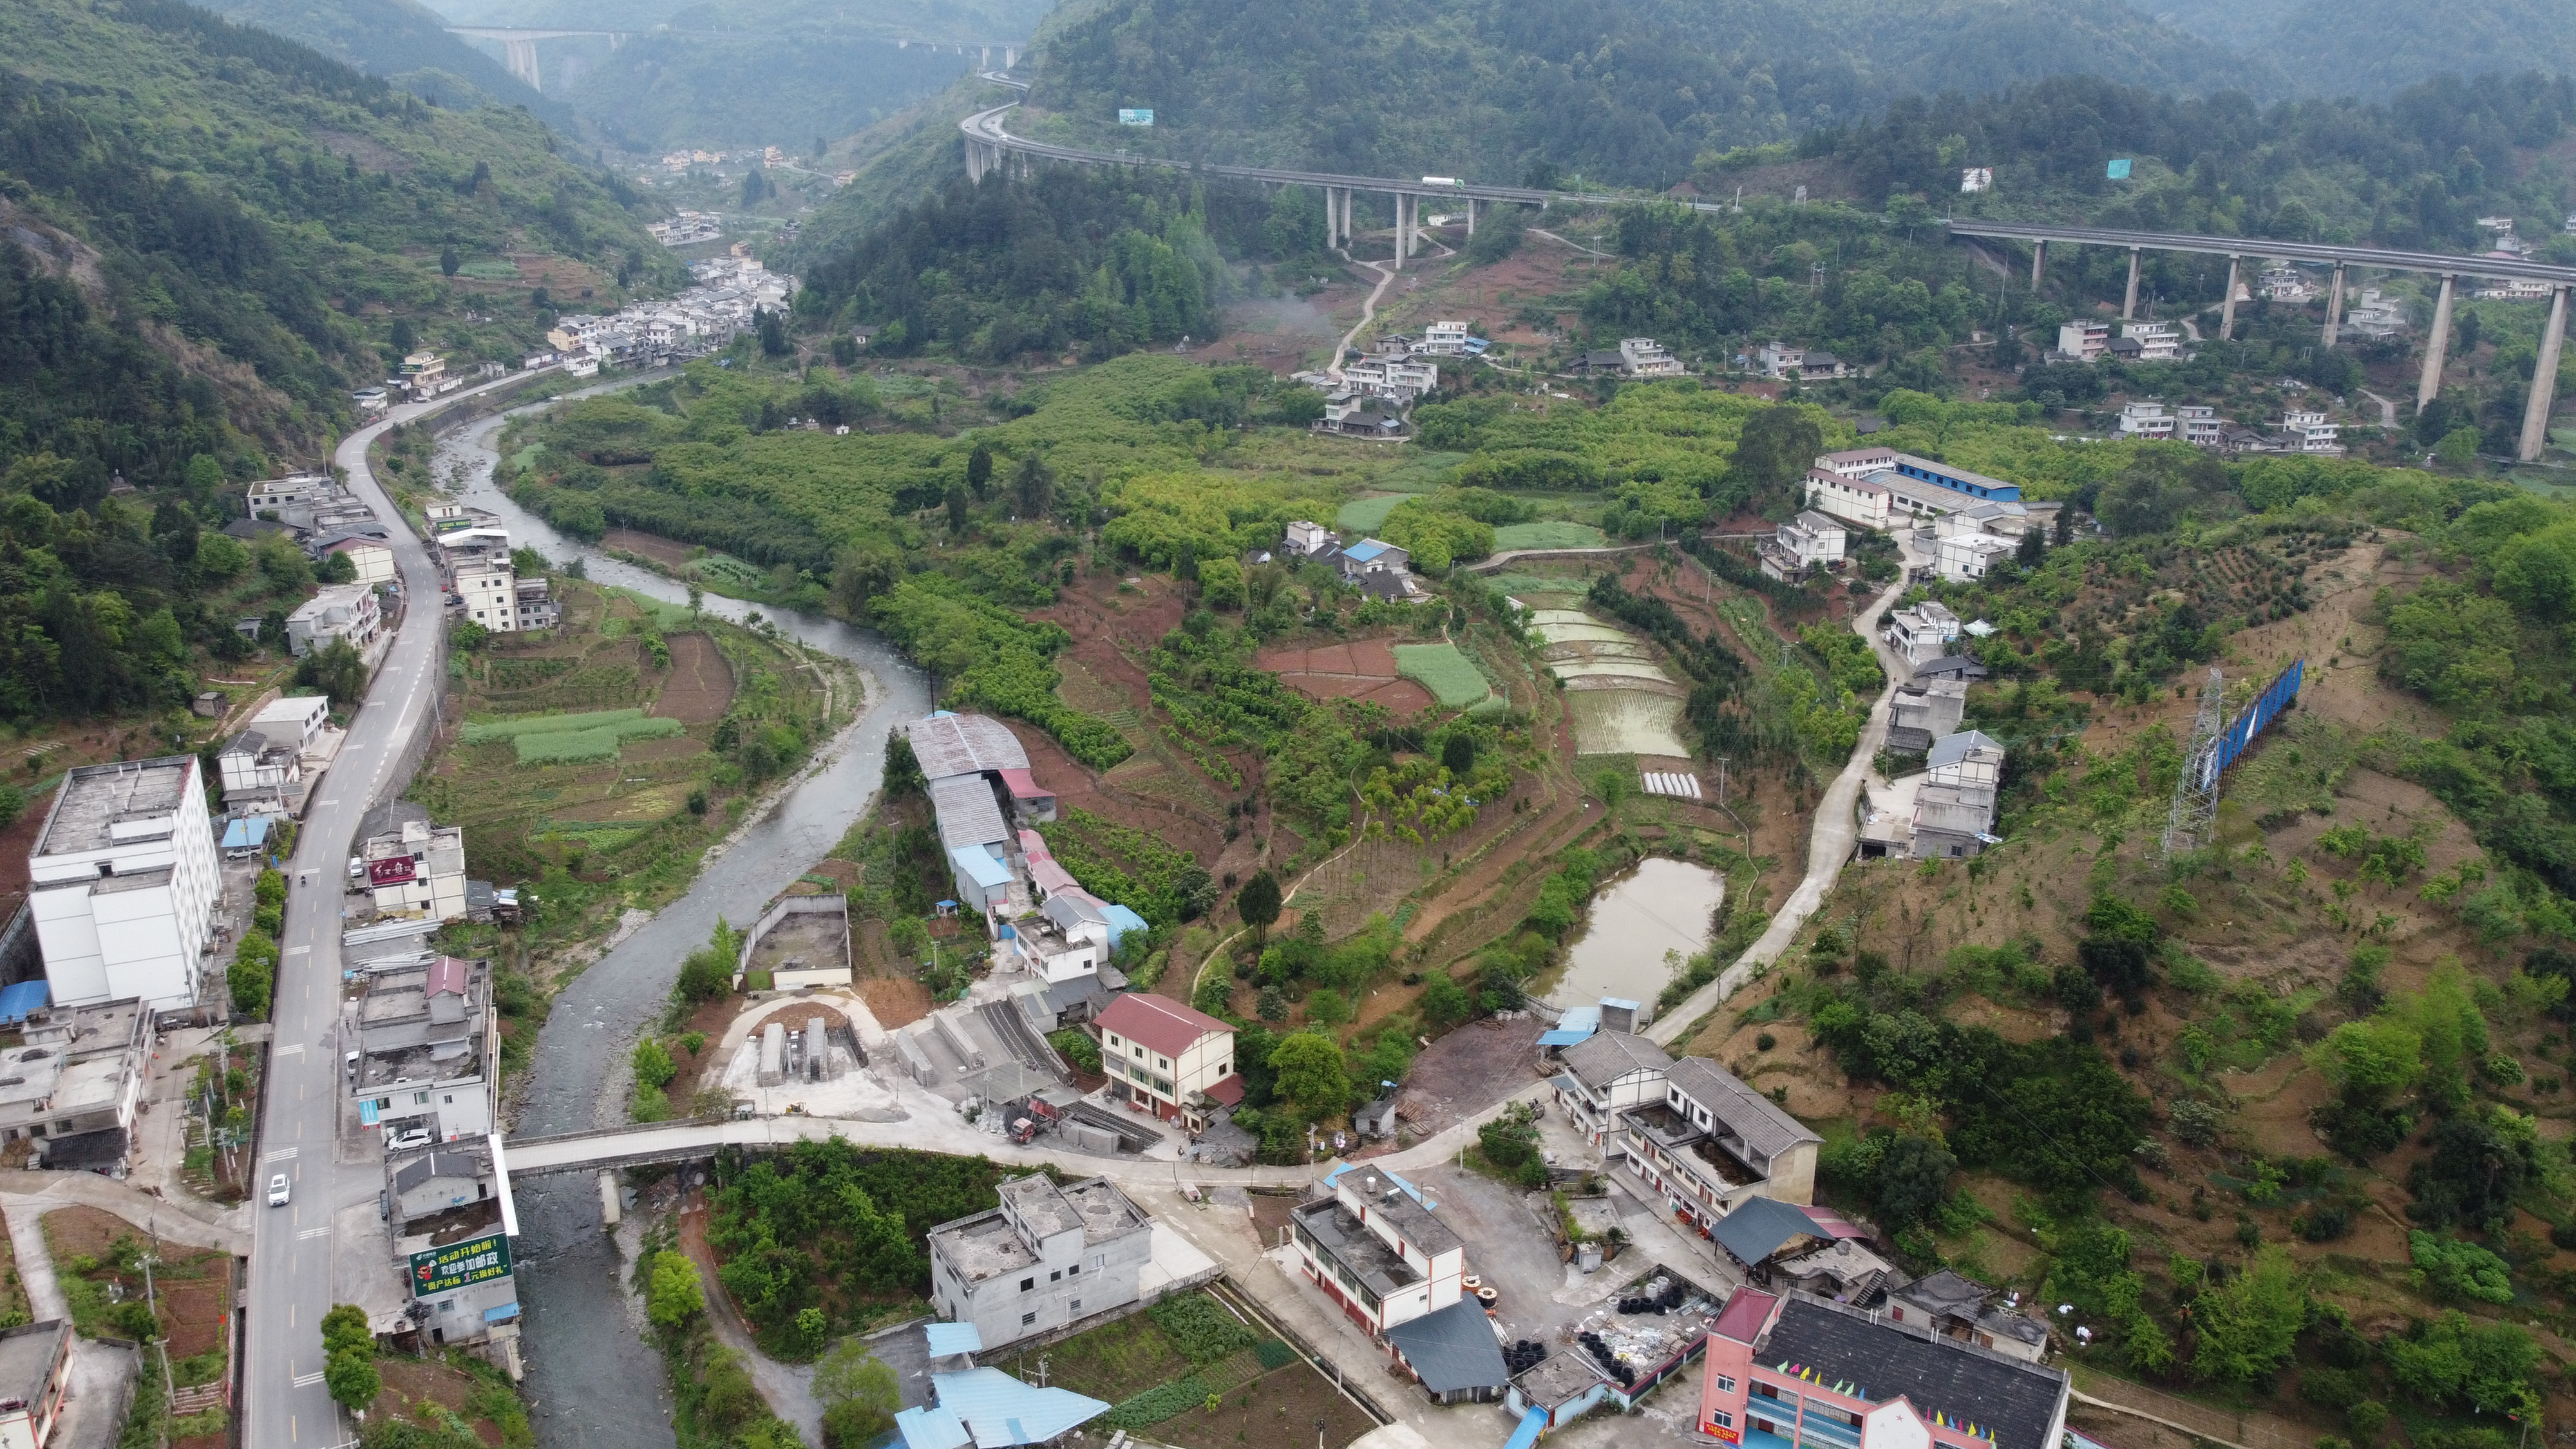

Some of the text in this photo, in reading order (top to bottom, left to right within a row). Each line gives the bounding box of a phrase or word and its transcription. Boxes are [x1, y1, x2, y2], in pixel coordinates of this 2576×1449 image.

[440, 1251, 499, 1276] 欢迎参加邮政
